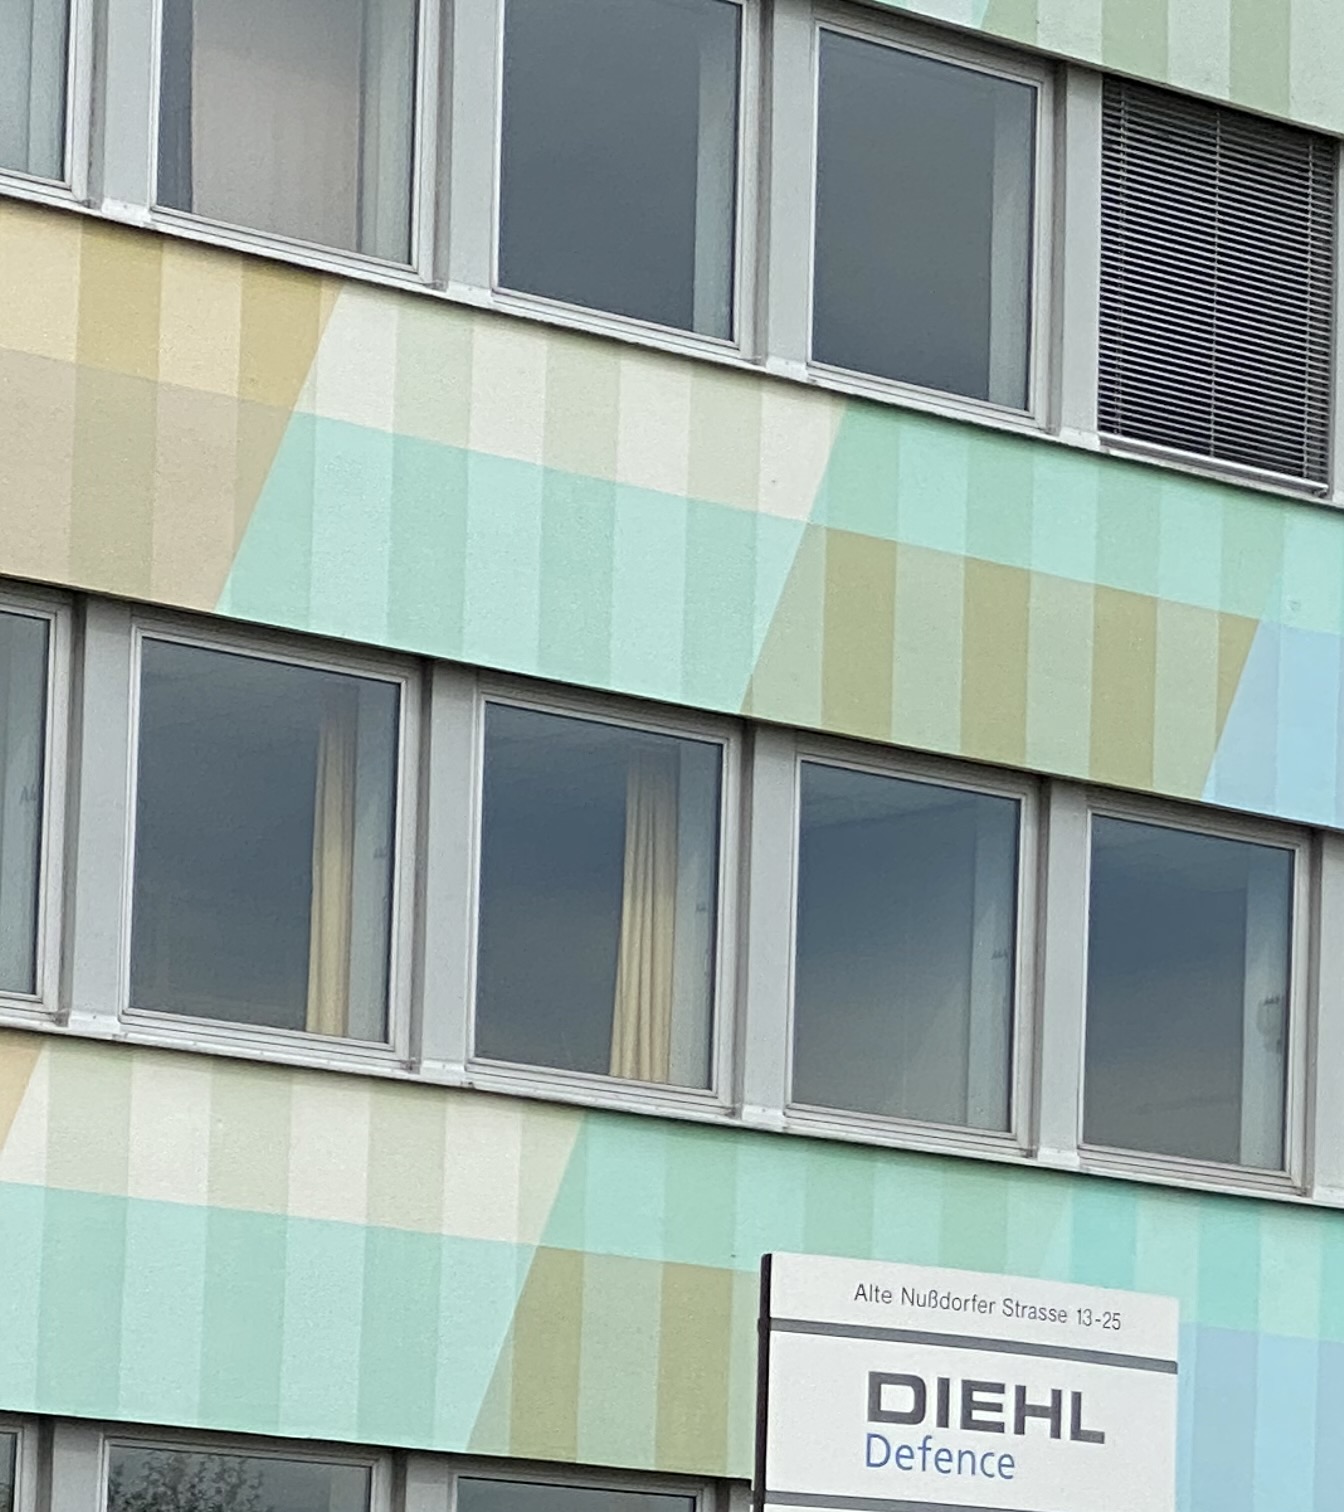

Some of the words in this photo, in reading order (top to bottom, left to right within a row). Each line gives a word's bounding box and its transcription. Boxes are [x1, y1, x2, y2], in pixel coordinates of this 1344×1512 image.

[854, 1283, 892, 1304] Alte
[901, 1287, 997, 1315] Nußdorfer
[1002, 1298, 1068, 1324] Strasse
[1076, 1308, 1121, 1331] 13-25
[867, 1371, 1106, 1445] DIEHL
[864, 1432, 1016, 1480] Defence
